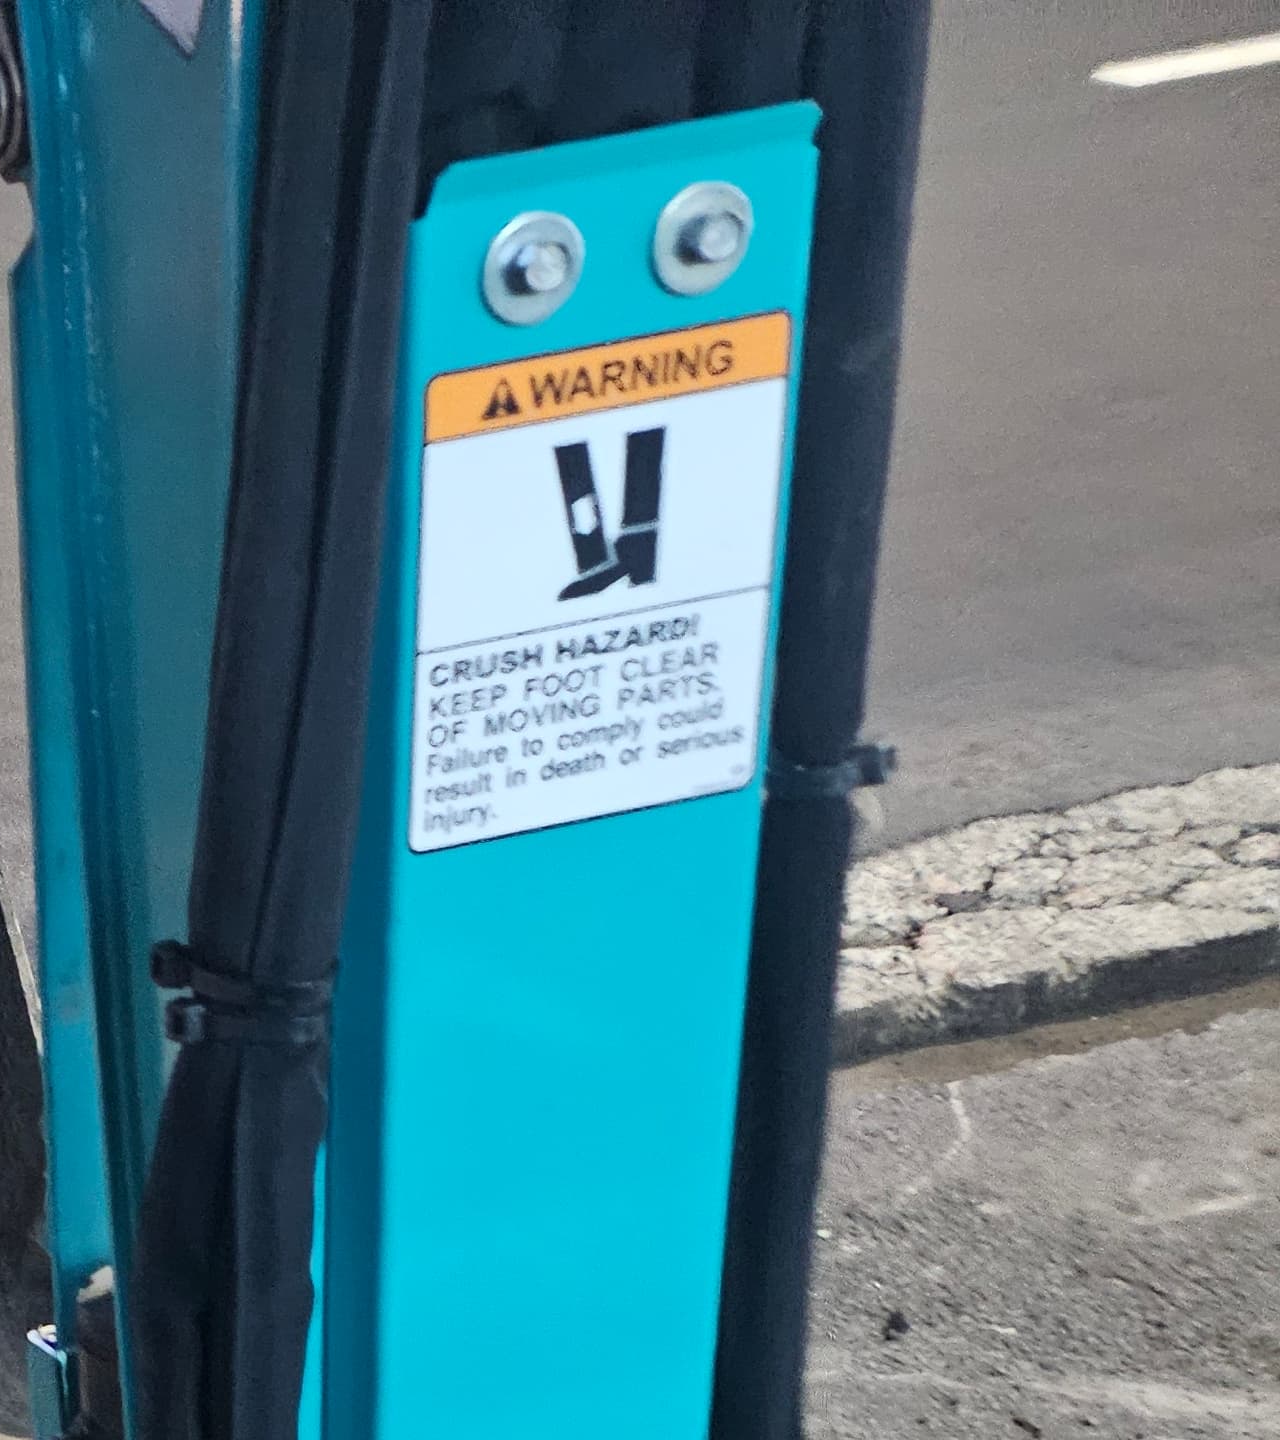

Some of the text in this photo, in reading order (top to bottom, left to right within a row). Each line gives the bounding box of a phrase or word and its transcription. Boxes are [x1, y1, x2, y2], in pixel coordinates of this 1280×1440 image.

[530, 340, 733, 410] WARNING
[428, 613, 701, 688] CRUSH HAZARD!
[428, 643, 719, 720] KEEP FOOT CLEAR
[426, 697, 724, 776] Failure to comply could
[428, 672, 719, 748] OF MOVING PARTS.
[424, 724, 744, 805] result in death or serious
[423, 798, 497, 834] injury.
